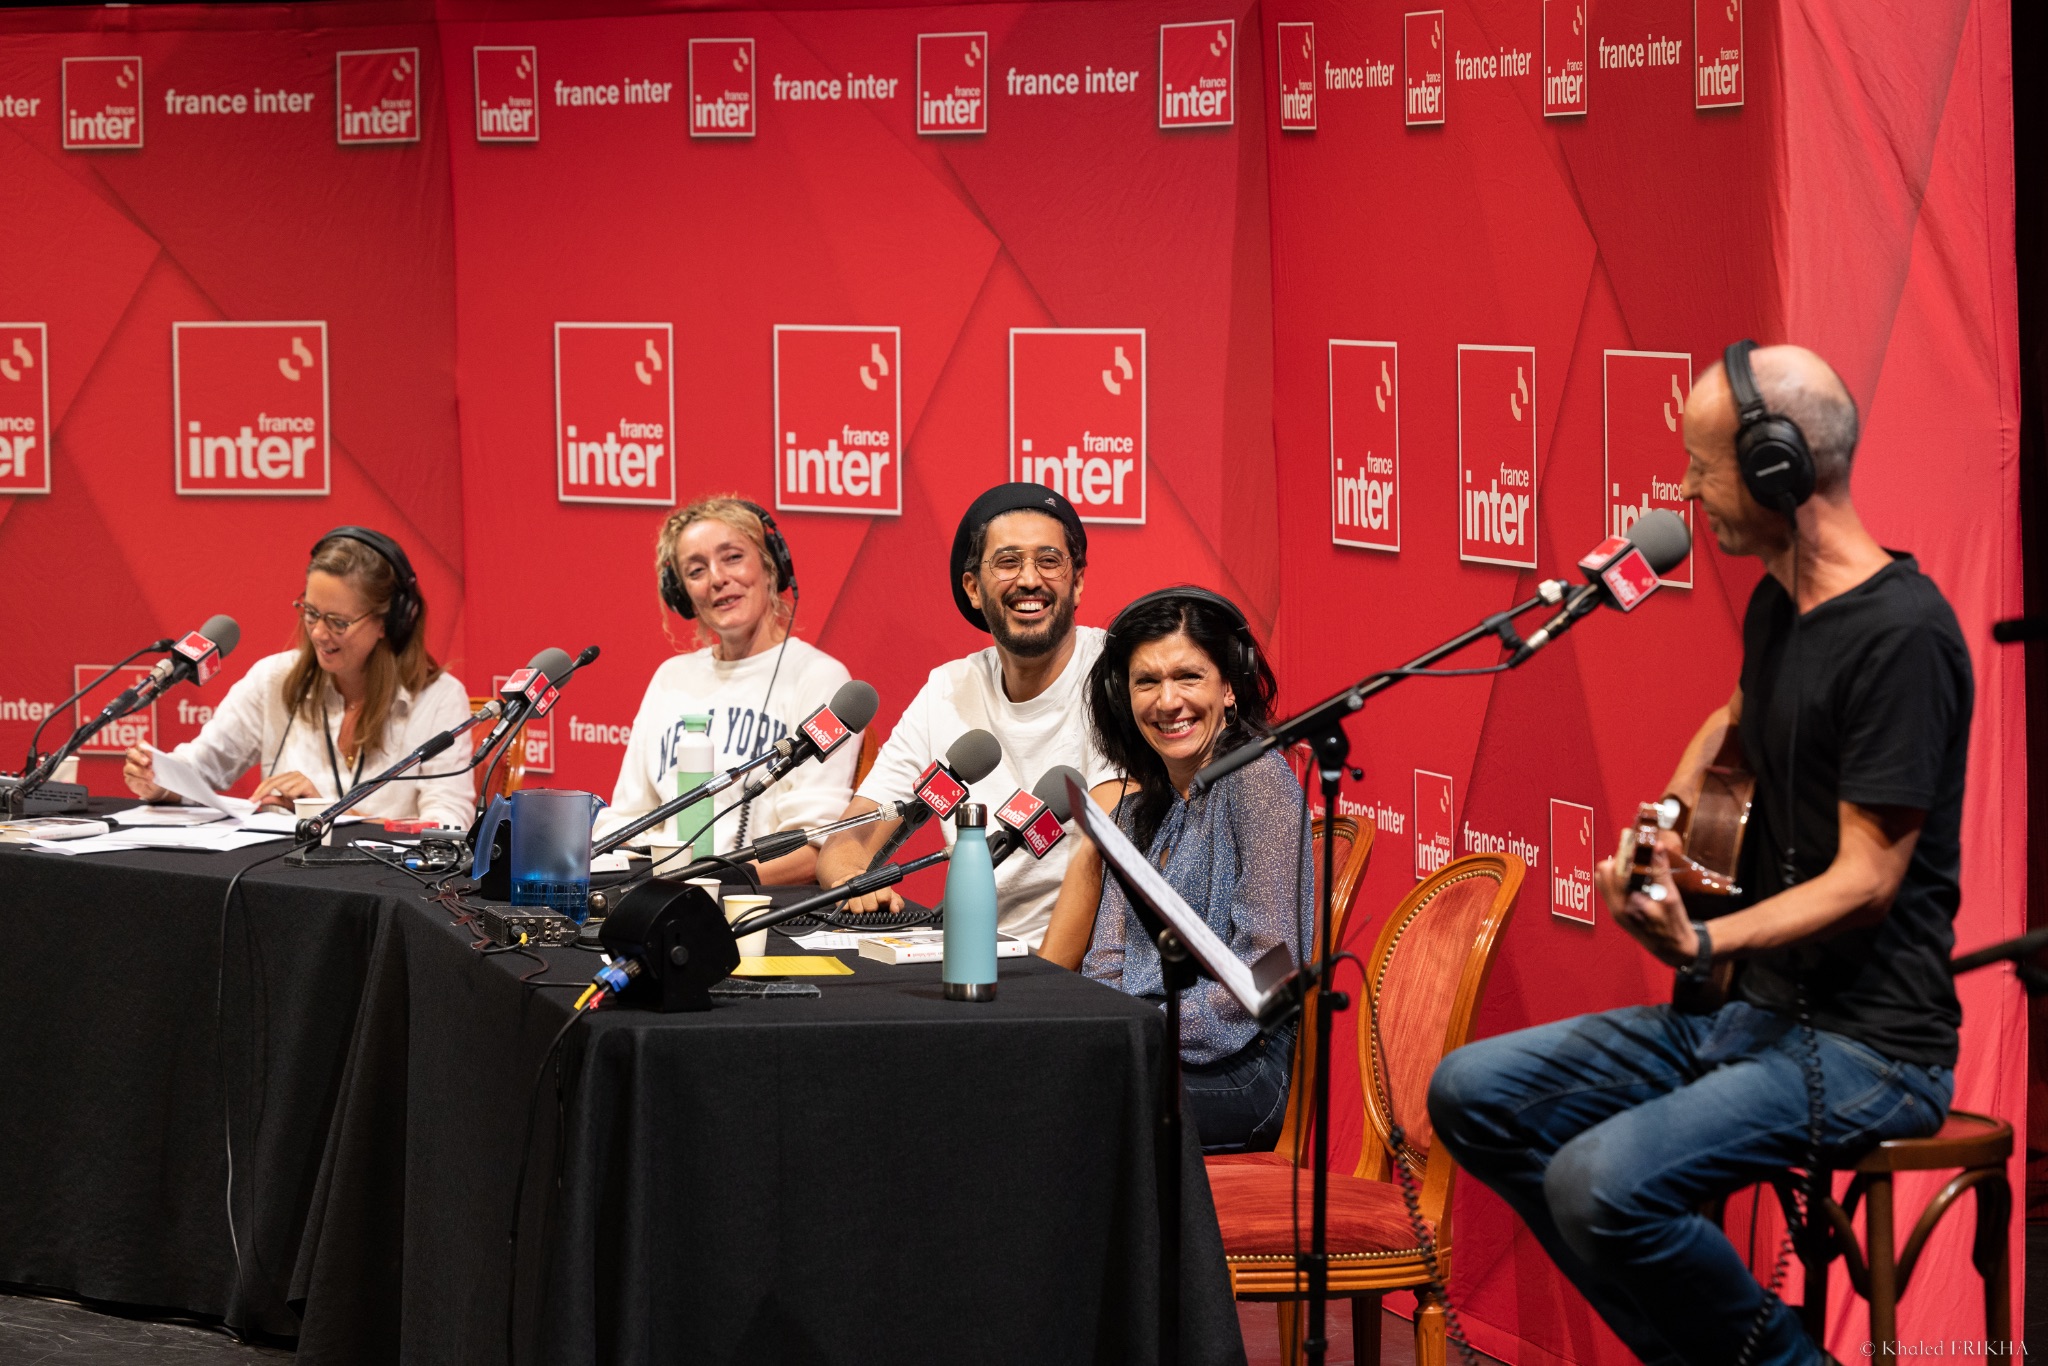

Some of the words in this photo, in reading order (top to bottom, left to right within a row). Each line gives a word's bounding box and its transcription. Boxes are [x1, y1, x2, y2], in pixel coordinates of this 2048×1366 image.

[1455, 50, 1497, 80] france
[1501, 47, 1532, 77] inter
[1599, 37, 1645, 68] france
[1648, 34, 1682, 66] inter
[1720, 48, 1739, 61] france
[773, 74, 841, 101] france
[848, 73, 898, 99] inter
[1007, 68, 1080, 95] france
[1086, 66, 1139, 93] inter
[1200, 77, 1227, 88] france
[1325, 61, 1363, 89] france
[1366, 59, 1395, 87] inter
[1547, 66, 1583, 104] inter
[1700, 56, 1739, 96] inter
[0, 95, 41, 118] ter
[165, 89, 248, 114] france
[254, 88, 314, 113] inter
[555, 80, 620, 106] france
[625, 78, 672, 103] inter
[1166, 84, 1226, 117] inter
[1284, 85, 1313, 119] inter
[1409, 78, 1441, 114] inter
[345, 105, 411, 135] inter
[482, 101, 532, 132] inter
[696, 95, 749, 127] inter
[924, 93, 980, 124] inter
[70, 110, 136, 140] inter
[258, 413, 315, 432] france
[620, 418, 663, 440] france
[843, 425, 889, 447] france
[189, 421, 315, 479] inter
[568, 426, 664, 487] inter
[1083, 431, 1134, 453] france
[787, 432, 889, 496] inter
[1022, 439, 1133, 505] inter
[1366, 451, 1393, 475] france
[1500, 462, 1529, 487] france
[1337, 458, 1393, 530] inter
[1466, 470, 1529, 545] inter
[569, 715, 632, 746] france
[657, 708, 715, 783] NE
[806, 720, 831, 746] inter
[921, 786, 949, 811] inter
[1001, 805, 1025, 824] inter
[1377, 800, 1405, 834] inter
[1026, 825, 1046, 851] inter
[1418, 833, 1450, 872] inter
[1435, 832, 1450, 847] france
[1464, 821, 1505, 854] france
[1573, 866, 1591, 881] france
[1555, 867, 1591, 911] inter
